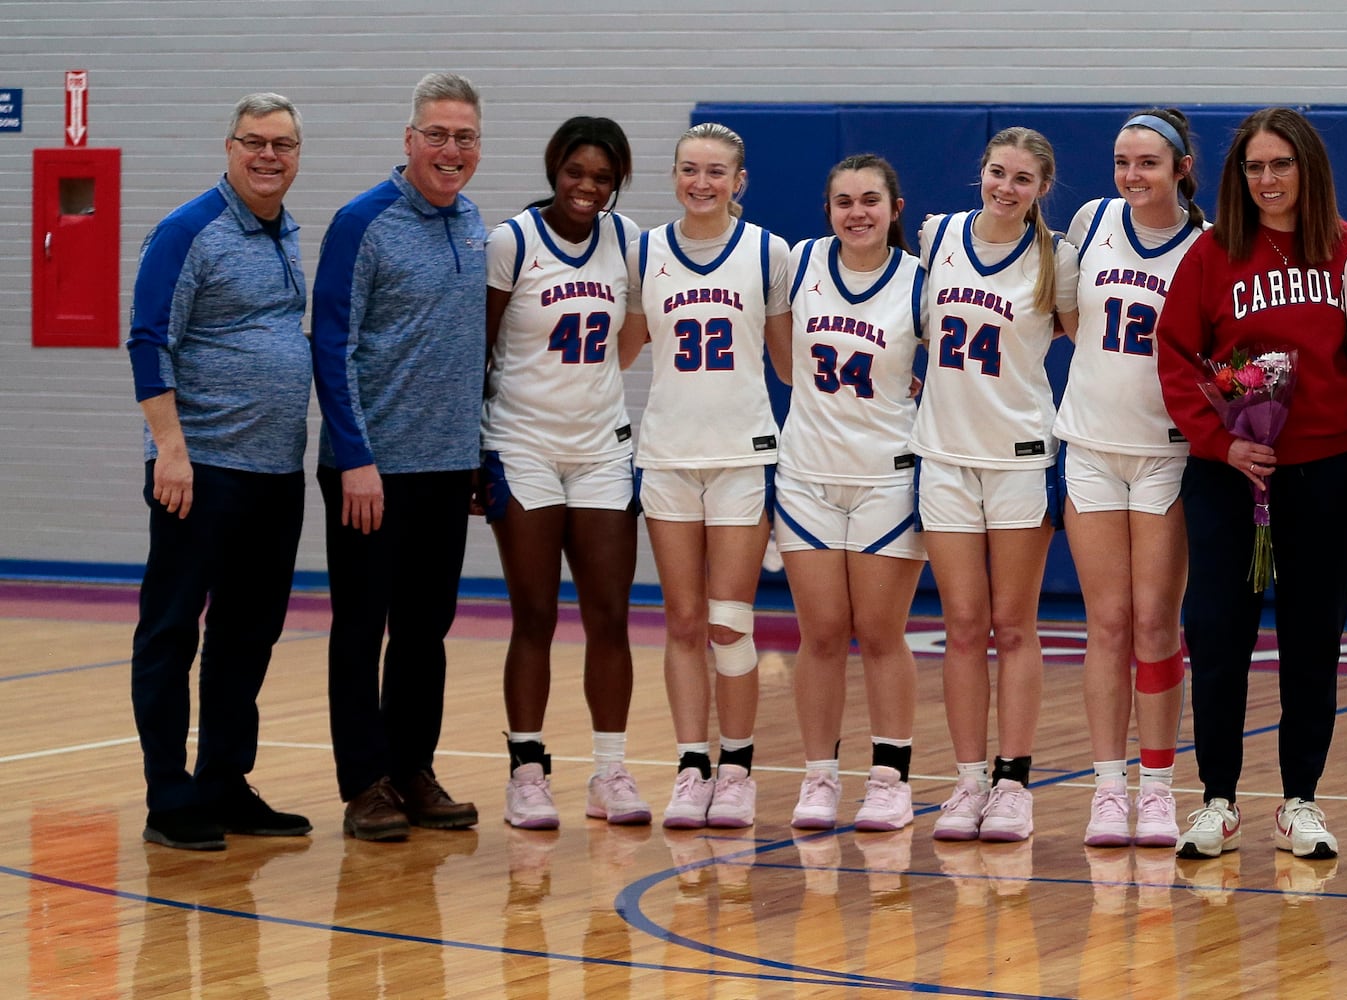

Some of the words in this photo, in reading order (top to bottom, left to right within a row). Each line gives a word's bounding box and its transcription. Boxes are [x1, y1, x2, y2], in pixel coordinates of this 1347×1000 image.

[540, 281, 616, 307] CARROLL
[663, 288, 744, 314] CARROLL
[936, 287, 1015, 322] CARROLL
[1233, 268, 1345, 320] CARROL
[546, 311, 612, 365] 42
[673, 317, 735, 373] 32
[806, 315, 887, 349] CARROLL
[938, 314, 1002, 378] 24
[1102, 296, 1159, 358] 12
[810, 343, 875, 400] 34
